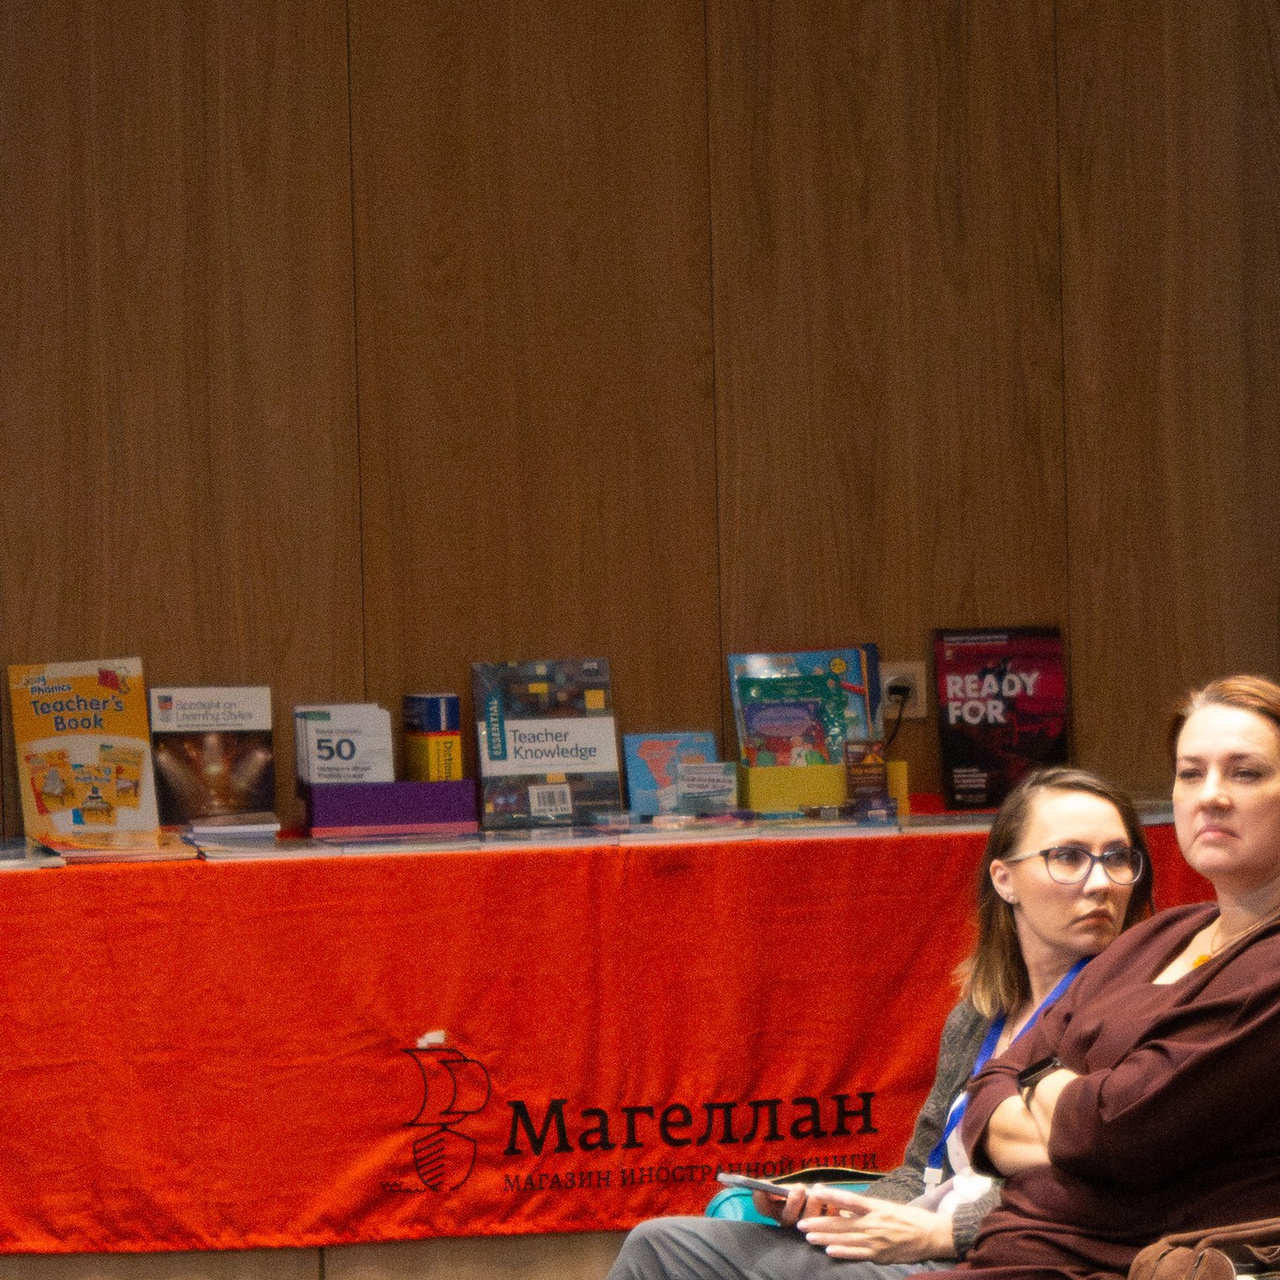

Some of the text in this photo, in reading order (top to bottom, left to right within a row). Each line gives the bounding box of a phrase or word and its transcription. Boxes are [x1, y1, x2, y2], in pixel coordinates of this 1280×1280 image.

[945, 670, 1039, 698] READY
[30, 694, 124, 716] Teacher's
[948, 699, 1006, 725] FOR
[53, 713, 104, 732] Book
[510, 728, 569, 744] Teacher
[317, 738, 356, 761] 50
[513, 743, 598, 761] Knowledge
[503, 1091, 879, 1157] Магеллан
[503, 1170, 611, 1192] МАГАЗИН
